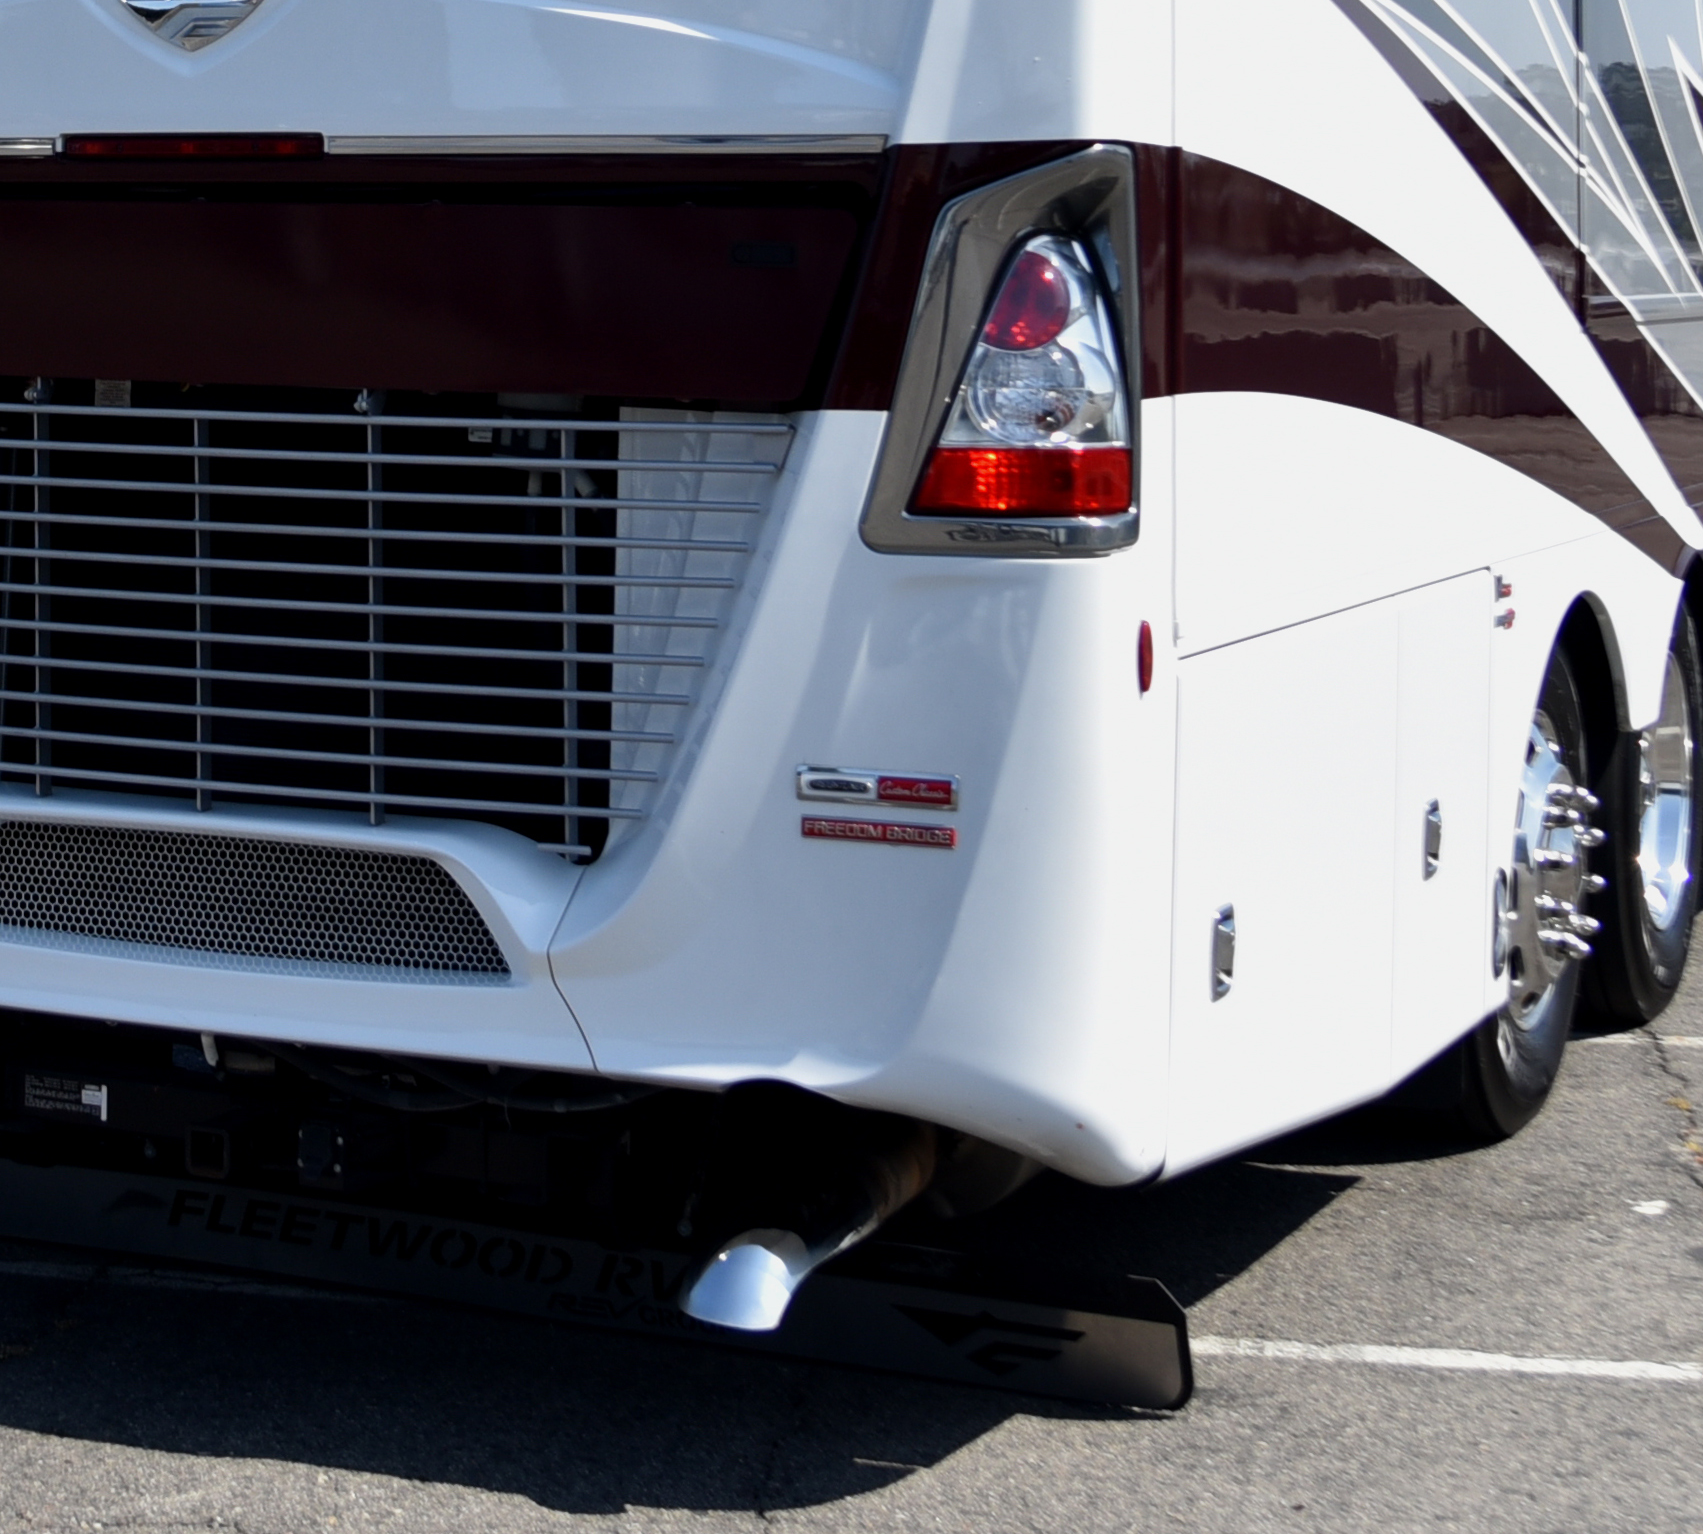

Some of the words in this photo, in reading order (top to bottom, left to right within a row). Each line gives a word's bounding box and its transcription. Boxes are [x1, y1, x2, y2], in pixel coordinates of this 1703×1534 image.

[804, 820, 883, 839] FREEDOM
[885, 826, 952, 844] BRIDGE
[167, 1188, 574, 1286] FLEETWOOD
[594, 1252, 689, 1302] RV
